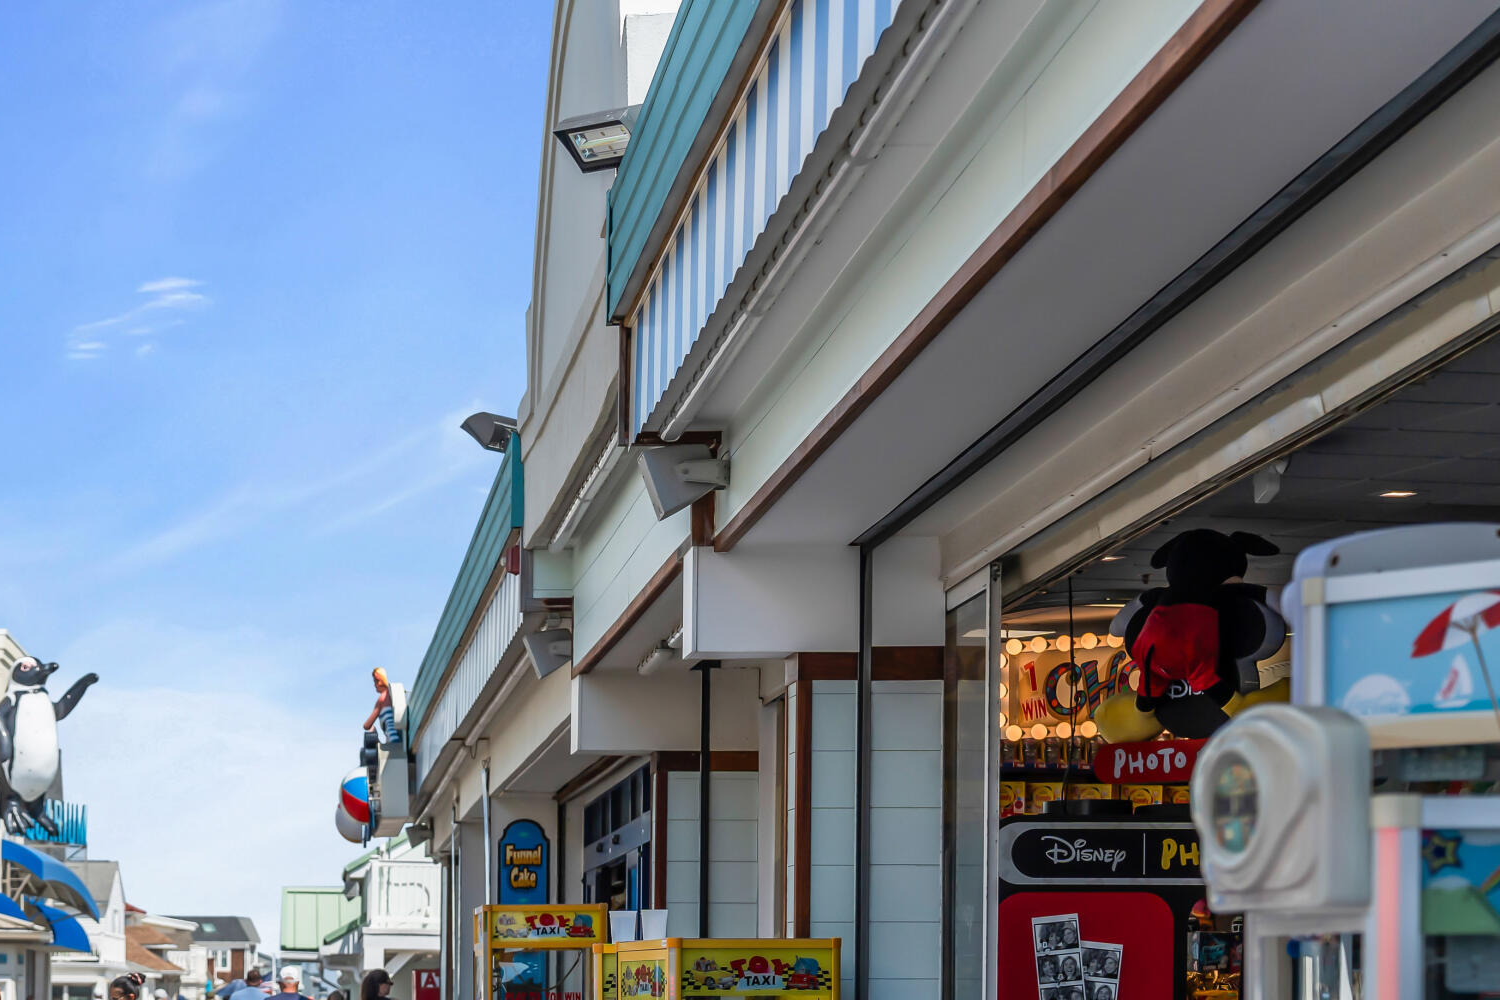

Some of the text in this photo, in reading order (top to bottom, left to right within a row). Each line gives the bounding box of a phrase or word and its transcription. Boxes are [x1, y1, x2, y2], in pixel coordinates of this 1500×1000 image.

[1021, 697, 1048, 721] WIN
[1113, 747, 1187, 779] PHOTO
[505, 844, 542, 865] Funnel
[510, 866, 537, 889] Cake
[525, 912, 571, 930] TOY
[536, 926, 561, 936] TAXI
[729, 956, 790, 978] TOY
[744, 974, 776, 987] TAXI
